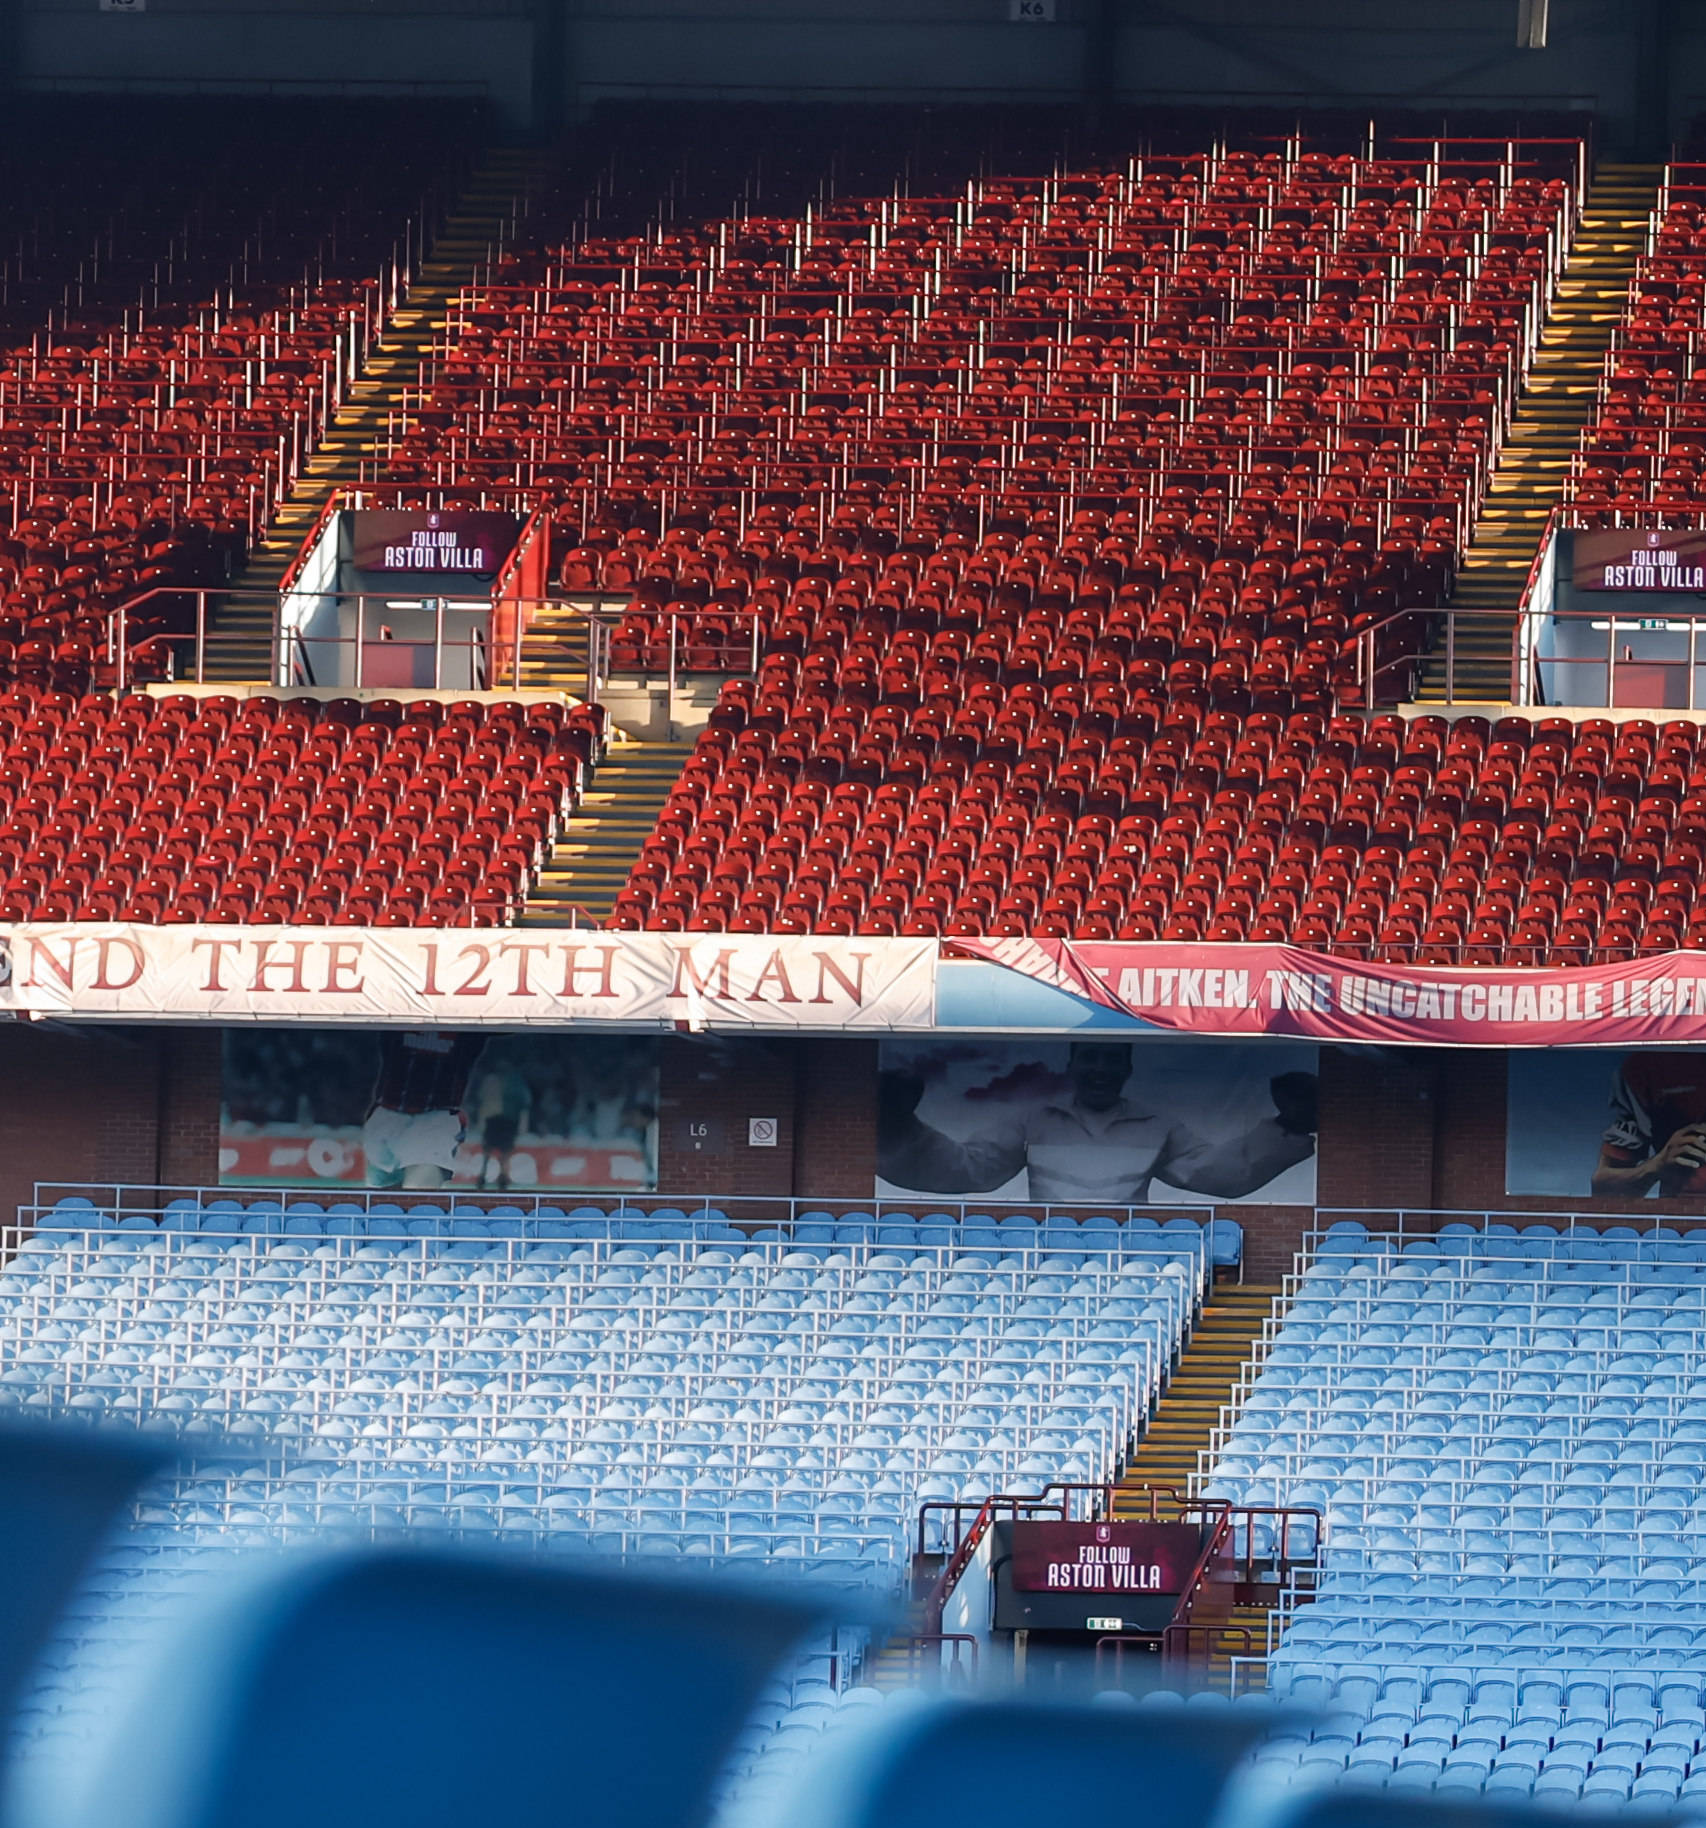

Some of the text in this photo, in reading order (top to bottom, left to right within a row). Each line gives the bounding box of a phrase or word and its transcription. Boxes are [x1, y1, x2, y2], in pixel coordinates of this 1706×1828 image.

[412, 531, 457, 547] FOLLOW
[385, 546, 483, 569] ASTON VILLA
[1632, 550, 1677, 566] FOLLOW
[1604, 565, 1704, 588] ASTON VILLA
[192, 939, 367, 995] THE
[415, 943, 624, 998] 12TH
[666, 946, 874, 1008] MAN
[1117, 967, 1257, 1009] AITKEN.
[1266, 969, 1332, 1013] THE
[1340, 974, 1605, 1022] UNCATCHABLE
[690, 1123, 708, 1137] L6
[1079, 1546, 1130, 1564] FOLLOW
[1048, 1563, 1161, 1589] ASTON VILLA
